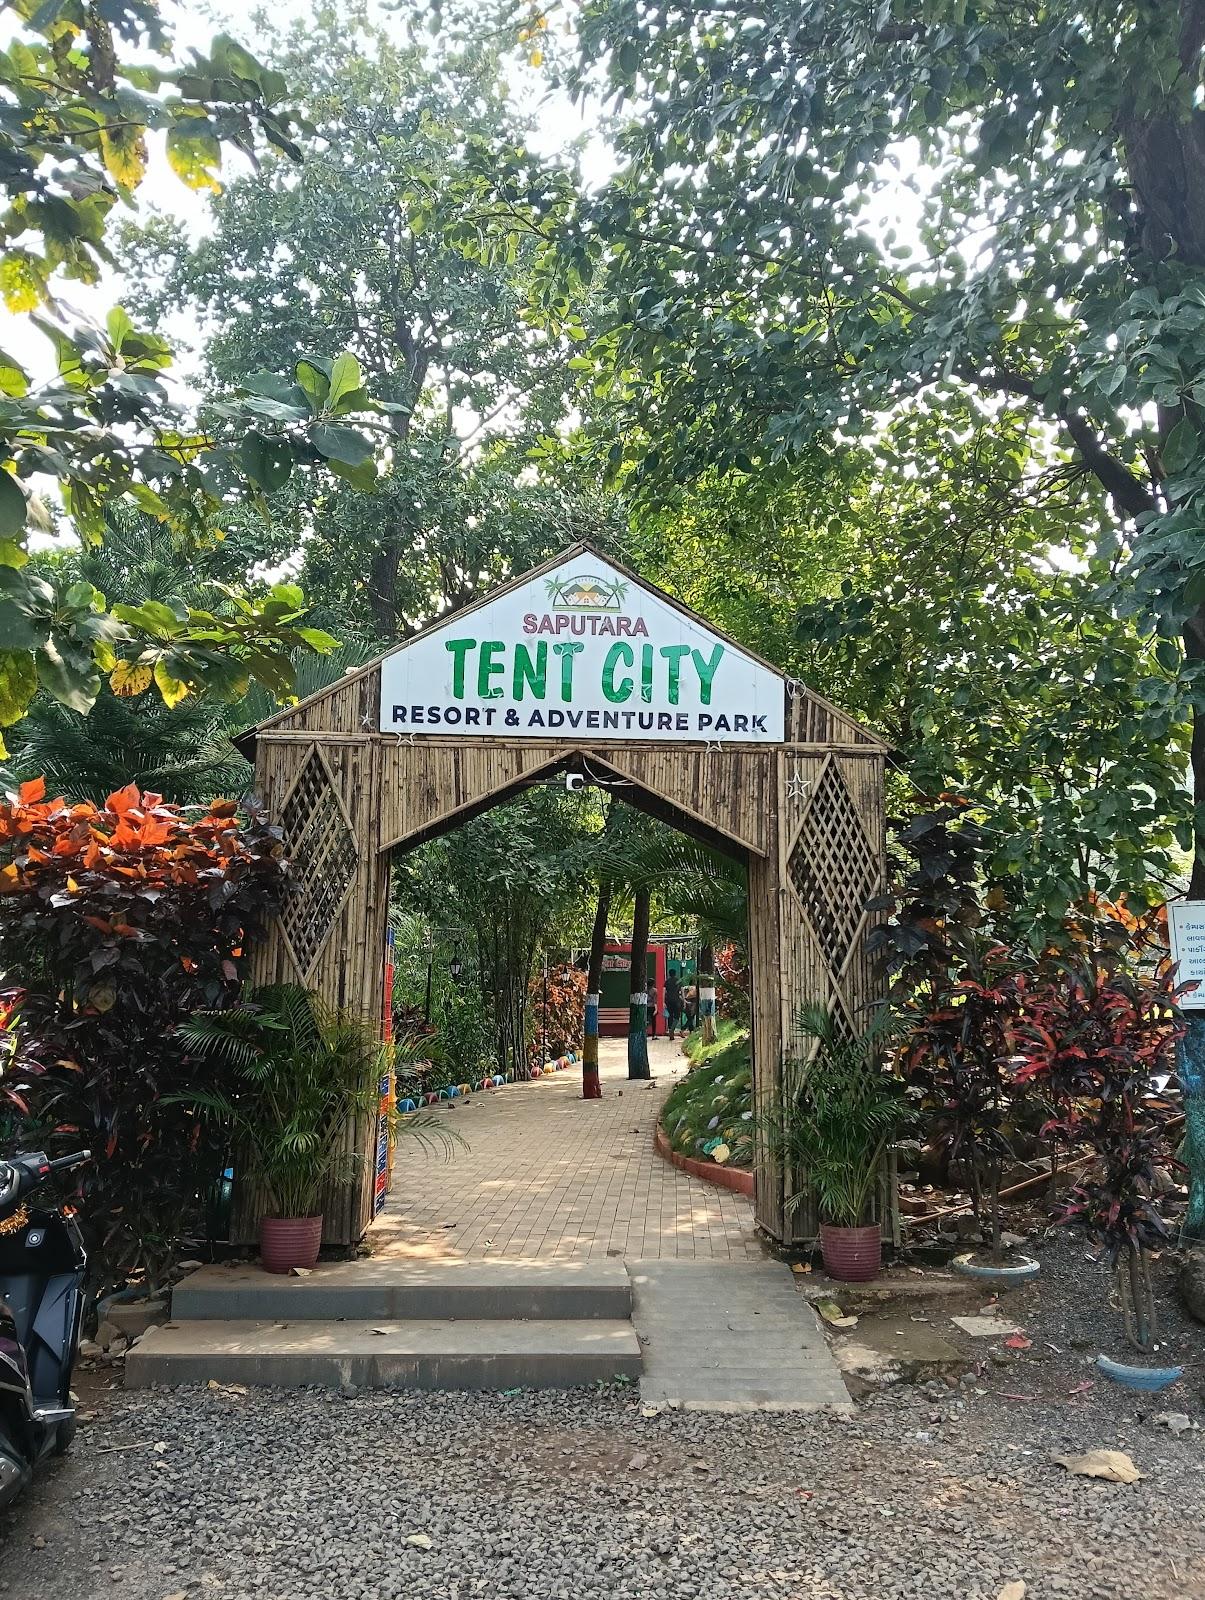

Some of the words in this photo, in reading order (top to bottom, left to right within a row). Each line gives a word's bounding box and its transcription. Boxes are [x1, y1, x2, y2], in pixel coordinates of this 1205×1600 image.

[522, 613, 649, 637] SAPUTARA
[445, 638, 585, 702] TENT
[601, 641, 725, 705] CITY
[392, 705, 497, 726] RESORT
[504, 708, 520, 727] &
[527, 709, 689, 730] ADVENTURE
[698, 713, 768, 733] PARK
